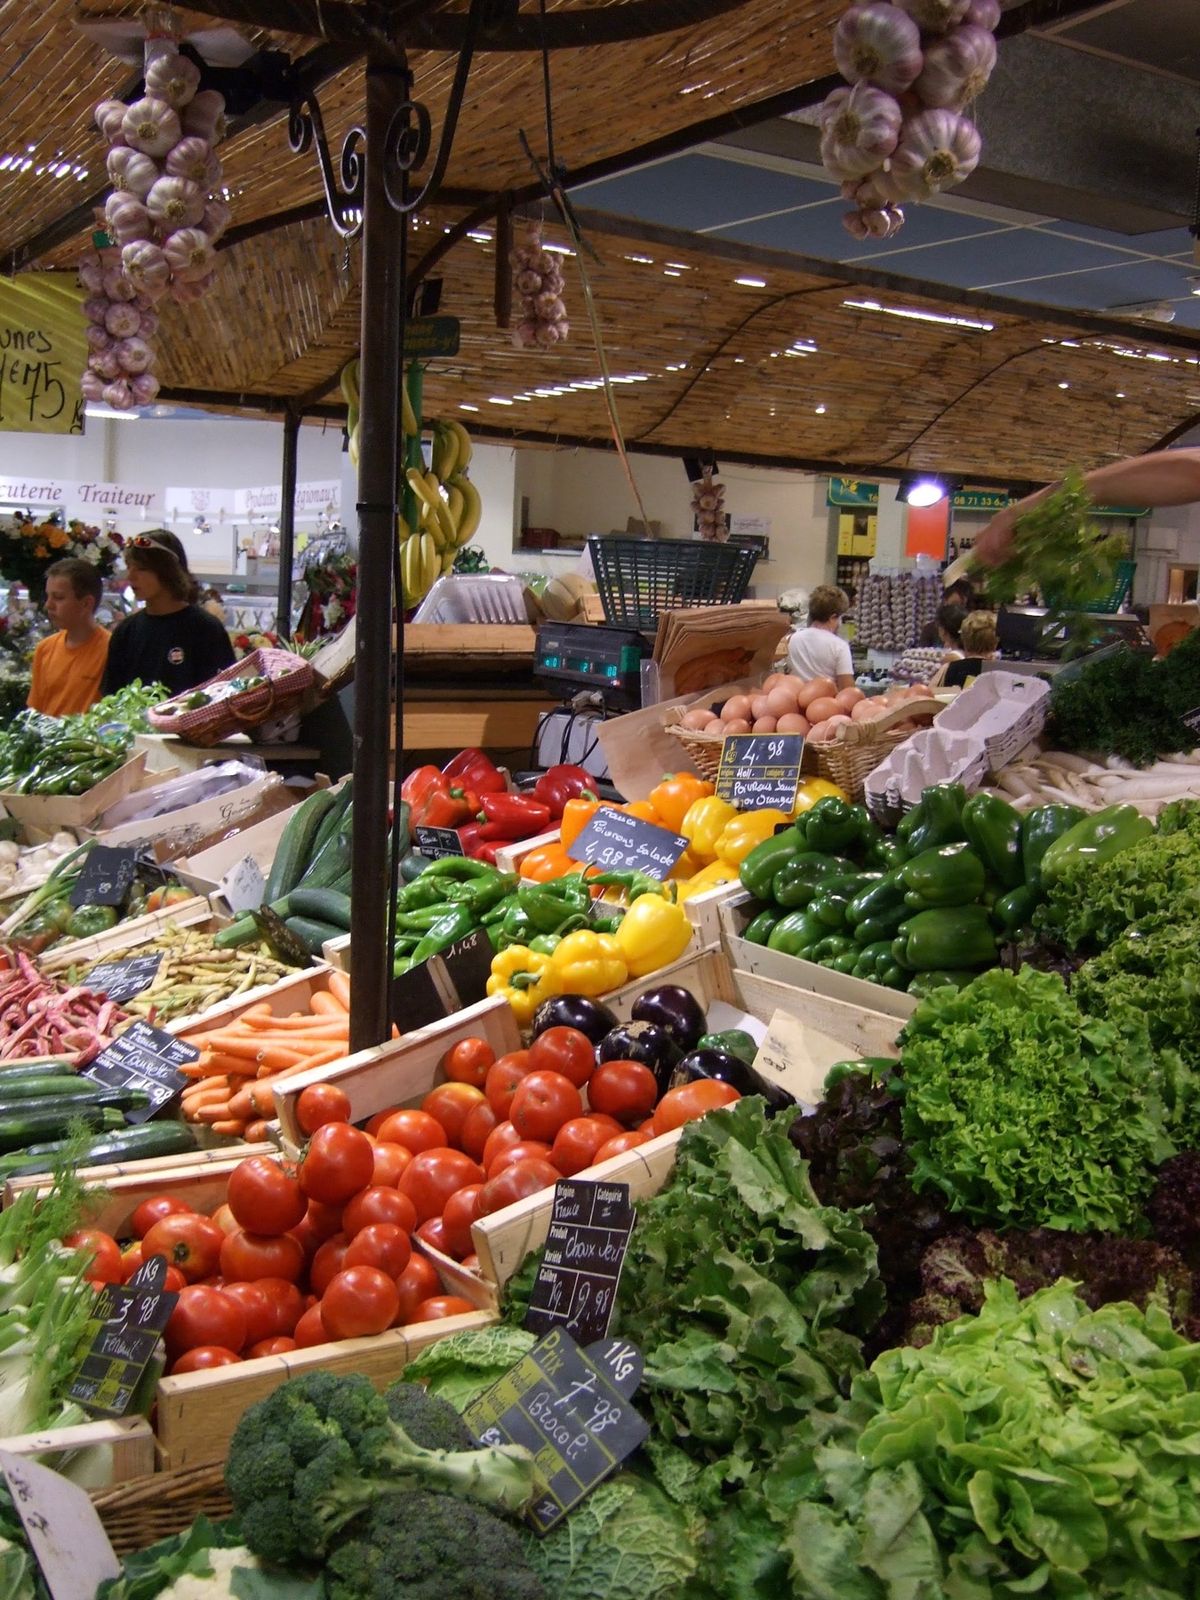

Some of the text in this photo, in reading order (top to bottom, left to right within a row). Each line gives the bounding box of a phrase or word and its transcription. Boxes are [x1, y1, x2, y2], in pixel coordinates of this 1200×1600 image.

[78, 484, 155, 506] Traiteur
[636, 843, 675, 866] Salade
[557, 1184, 623, 1204] Origine Catégorie
[550, 1225, 568, 1239] Produit
[545, 1249, 562, 1263] Variété
[135, 1257, 160, 1286] 1Kg
[539, 1267, 558, 1283] Calibre
[533, 1330, 565, 1377] Prix
[603, 1341, 636, 1382] 1Kg
